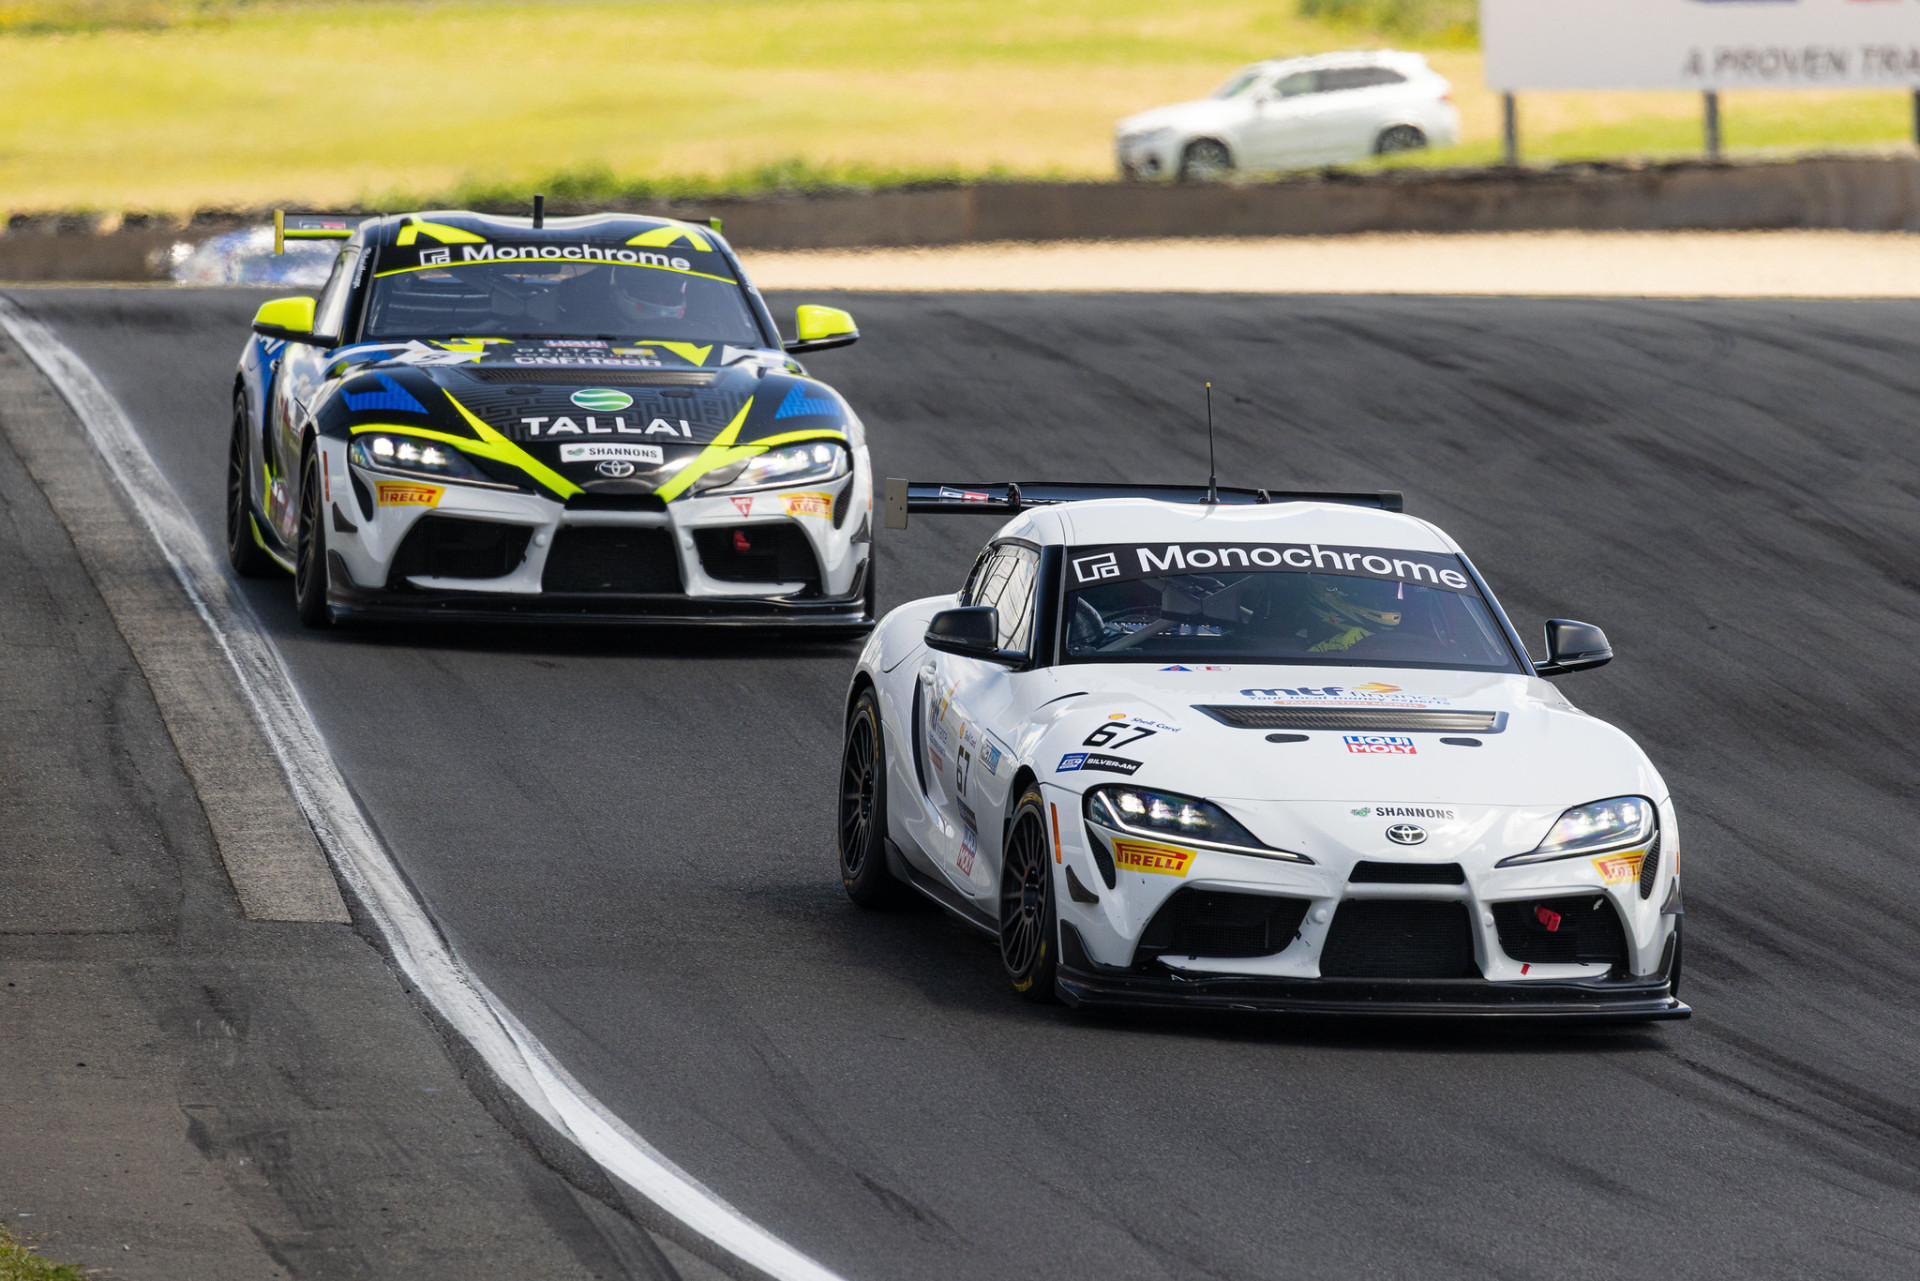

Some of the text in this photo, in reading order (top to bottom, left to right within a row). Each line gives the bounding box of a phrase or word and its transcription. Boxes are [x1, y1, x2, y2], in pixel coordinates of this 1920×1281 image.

[1713, 46, 1848, 78] PROVEN
[462, 244, 691, 271] Monochrome
[521, 416, 692, 438] TALLAI
[589, 447, 658, 458] SHANNONS
[379, 485, 437, 503] PIRELLI
[1136, 544, 1468, 589] Monochrome
[1240, 687, 1344, 697] mtf
[1131, 717, 1181, 732] Shell Card
[1082, 722, 1158, 749] 67
[1345, 736, 1411, 746] LIQUI
[1350, 744, 1413, 753] MOLY
[956, 744, 971, 797] 67
[1376, 806, 1455, 820] SHANNONS
[1115, 843, 1189, 871] PIRELLI
